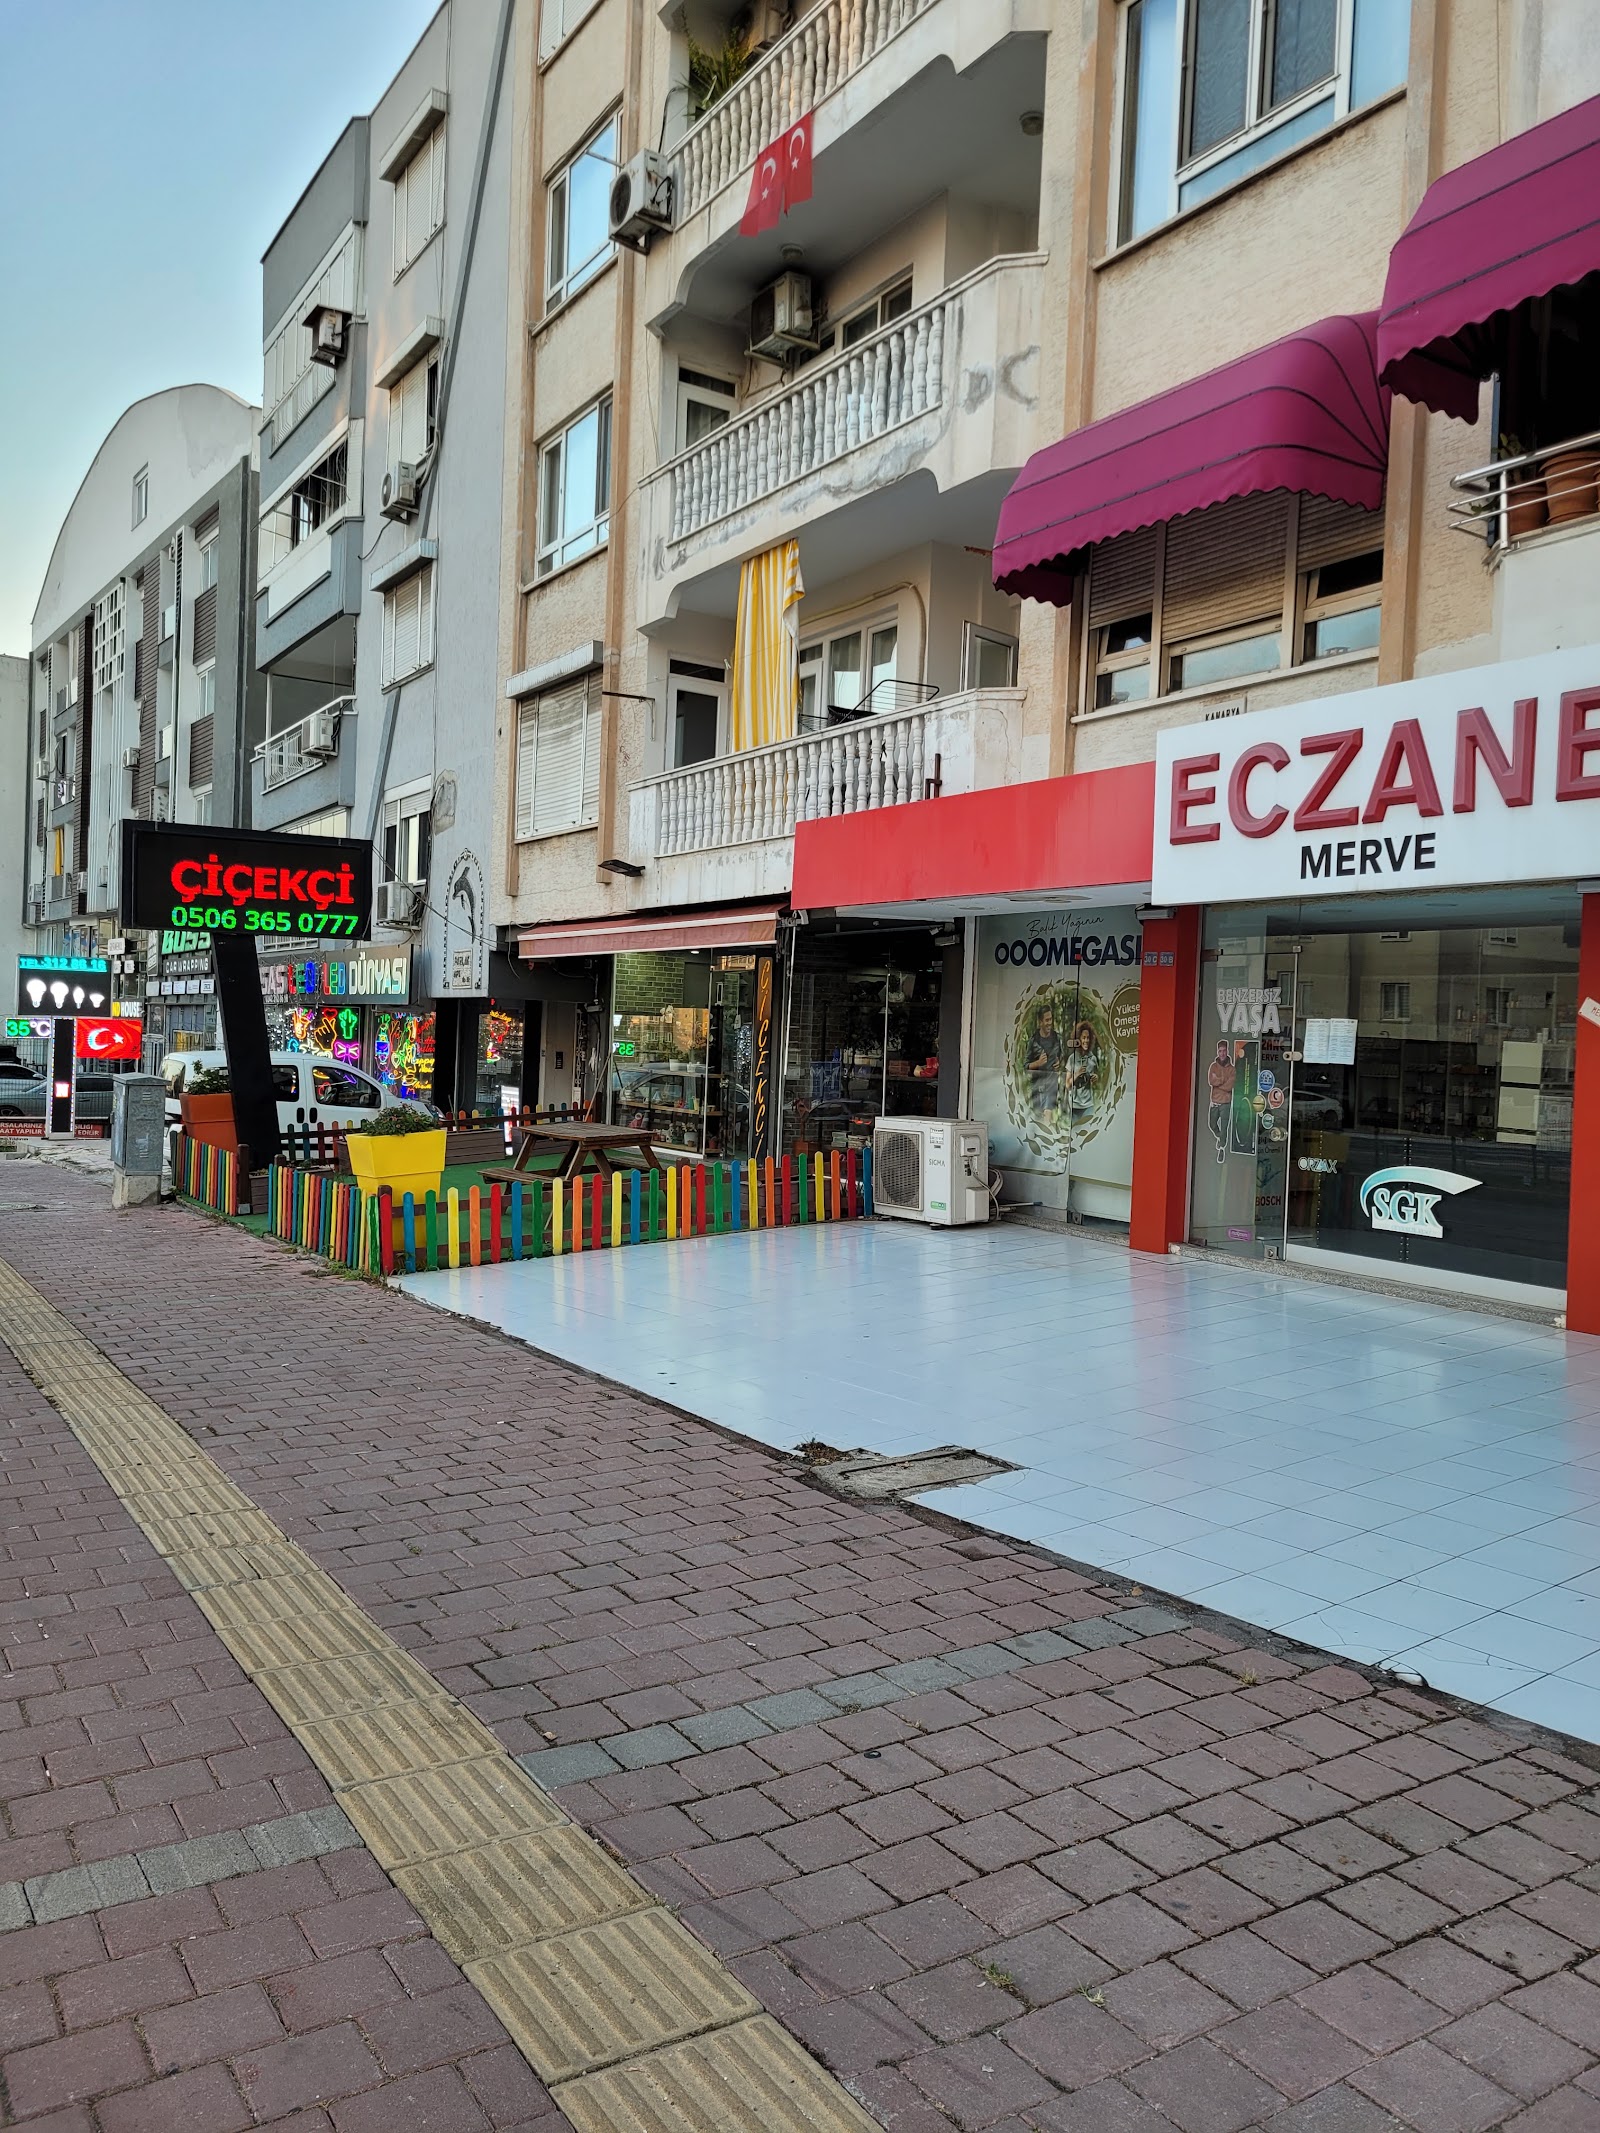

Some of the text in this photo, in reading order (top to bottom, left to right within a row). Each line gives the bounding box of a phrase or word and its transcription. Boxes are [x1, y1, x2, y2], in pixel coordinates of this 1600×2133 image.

[1205, 706, 1240, 721] KANARYA
[1169, 686, 1600, 845] ECZANE
[1300, 833, 1436, 880] MERVE
[170, 853, 355, 911] ÇİÇEKÇİ
[171, 906, 359, 935] 0506 365 0777
[323, 961, 346, 995] LED
[350, 951, 407, 995] DÜNYASI
[121, 1002, 142, 1017] HOUSE
[1217, 987, 1281, 1003] BENZERSİZ
[7, 1020, 51, 1037] 35°C
[1217, 1003, 1281, 1038] YAŞA
[1255, 1196, 1281, 1206] BOSCH
[1372, 1187, 1443, 1228] SGK
